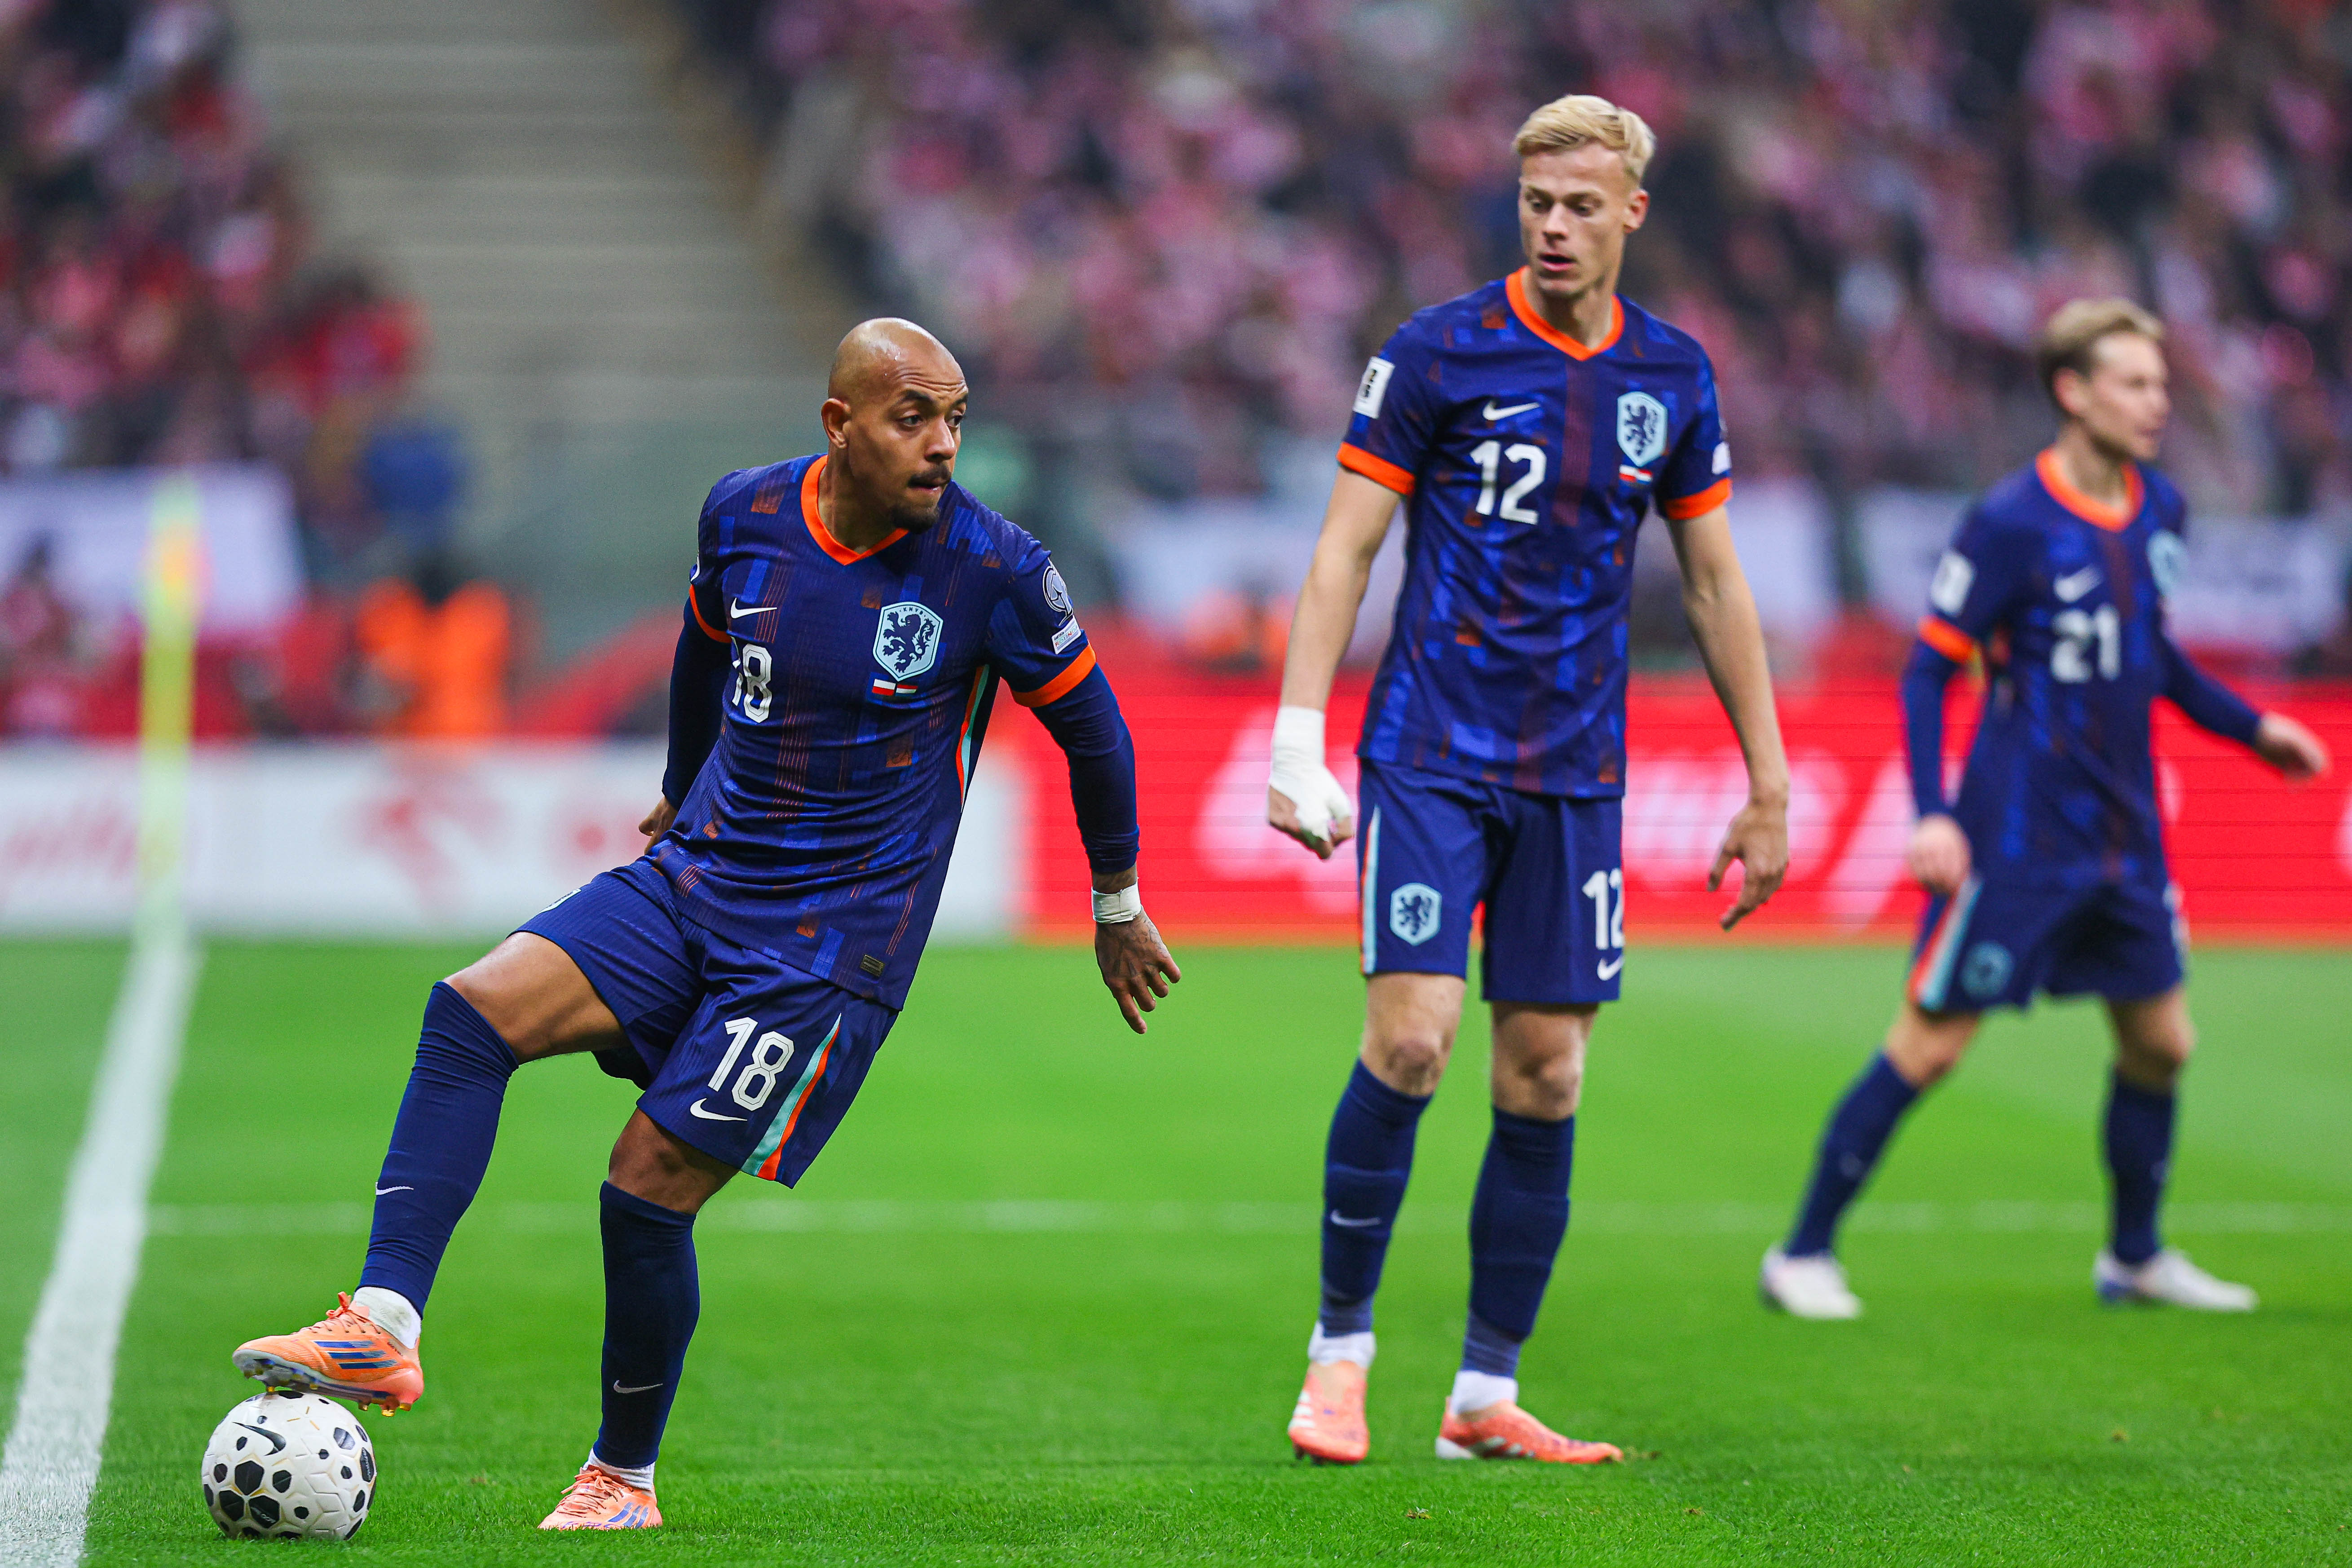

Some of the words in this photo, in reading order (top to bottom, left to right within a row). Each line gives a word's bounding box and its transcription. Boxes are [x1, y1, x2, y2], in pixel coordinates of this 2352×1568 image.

[1470, 440, 1547, 525] 12
[732, 644, 772, 723] 18
[2051, 604, 2120, 683] 21
[1581, 868, 1625, 950] 12
[707, 1017, 794, 1111] 18
